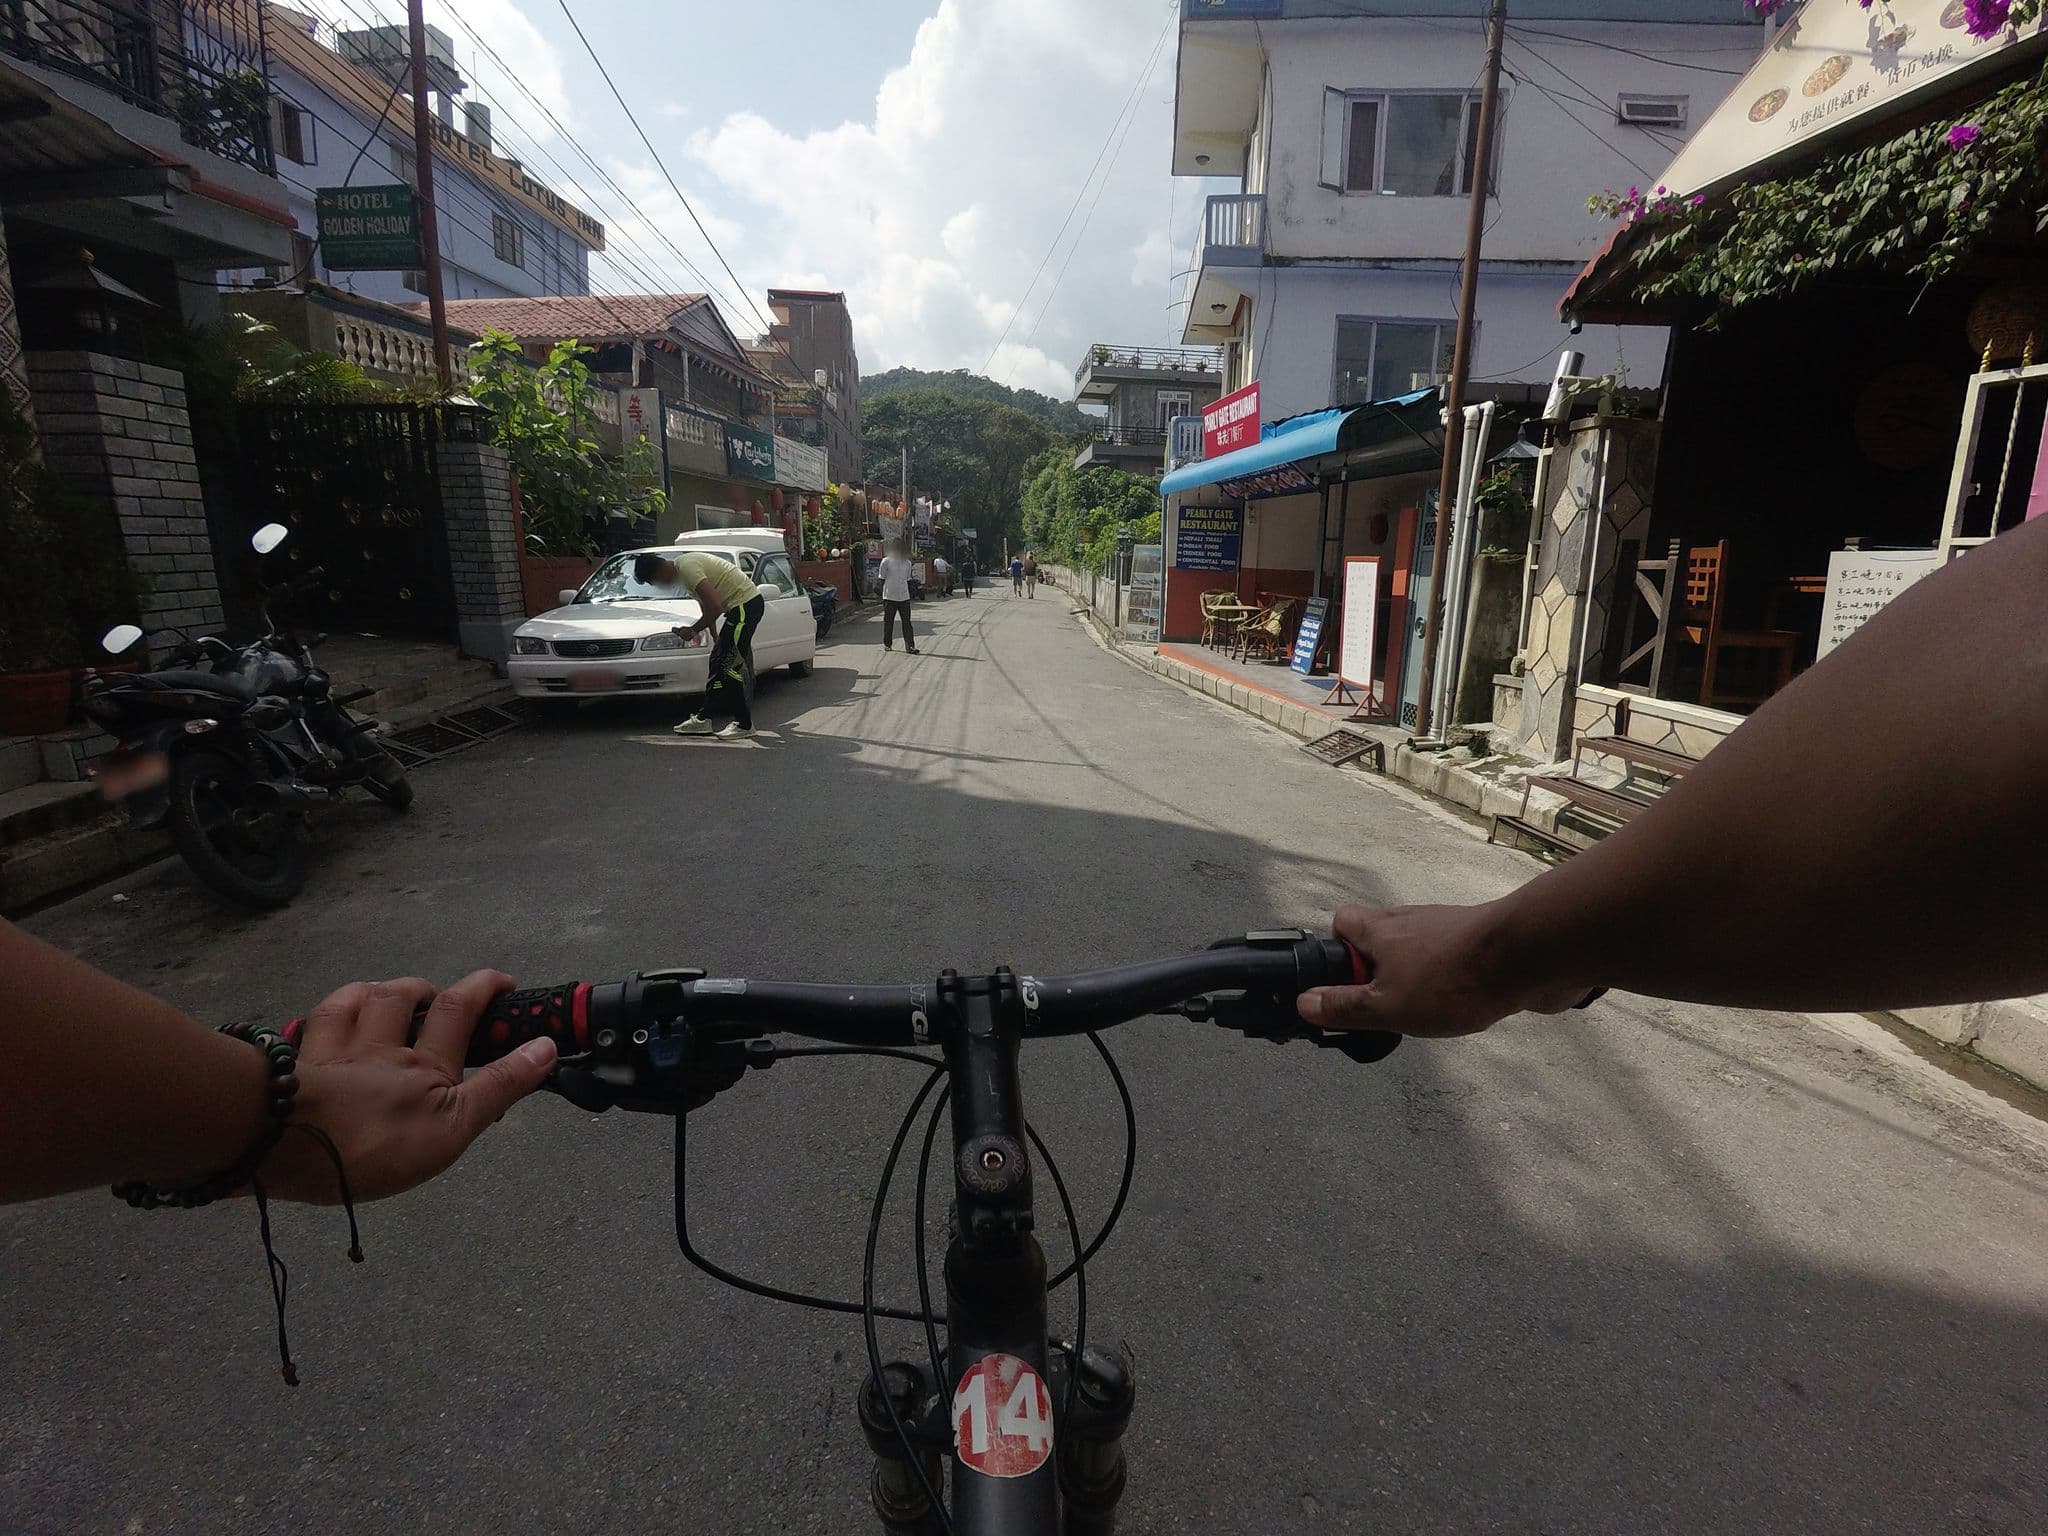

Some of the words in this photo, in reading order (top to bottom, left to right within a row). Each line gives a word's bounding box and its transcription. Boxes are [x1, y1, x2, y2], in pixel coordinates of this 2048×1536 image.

[428, 117, 495, 174] HOTEL
[509, 166, 567, 219] LOTUS
[577, 210, 603, 241] INN
[337, 192, 393, 210] HOTEL
[323, 216, 365, 236] GOLDEN
[366, 214, 411, 235] HOLIDAY
[1218, 405, 1230, 427] GATE
[1229, 392, 1257, 423] RESTAURANT
[744, 440, 772, 467] Carlsberg
[1180, 519, 1239, 530] RESTAURANT
[1185, 508, 1213, 518] PEARLY
[1214, 509, 1234, 519] GATE
[953, 1371, 1047, 1454] 14
